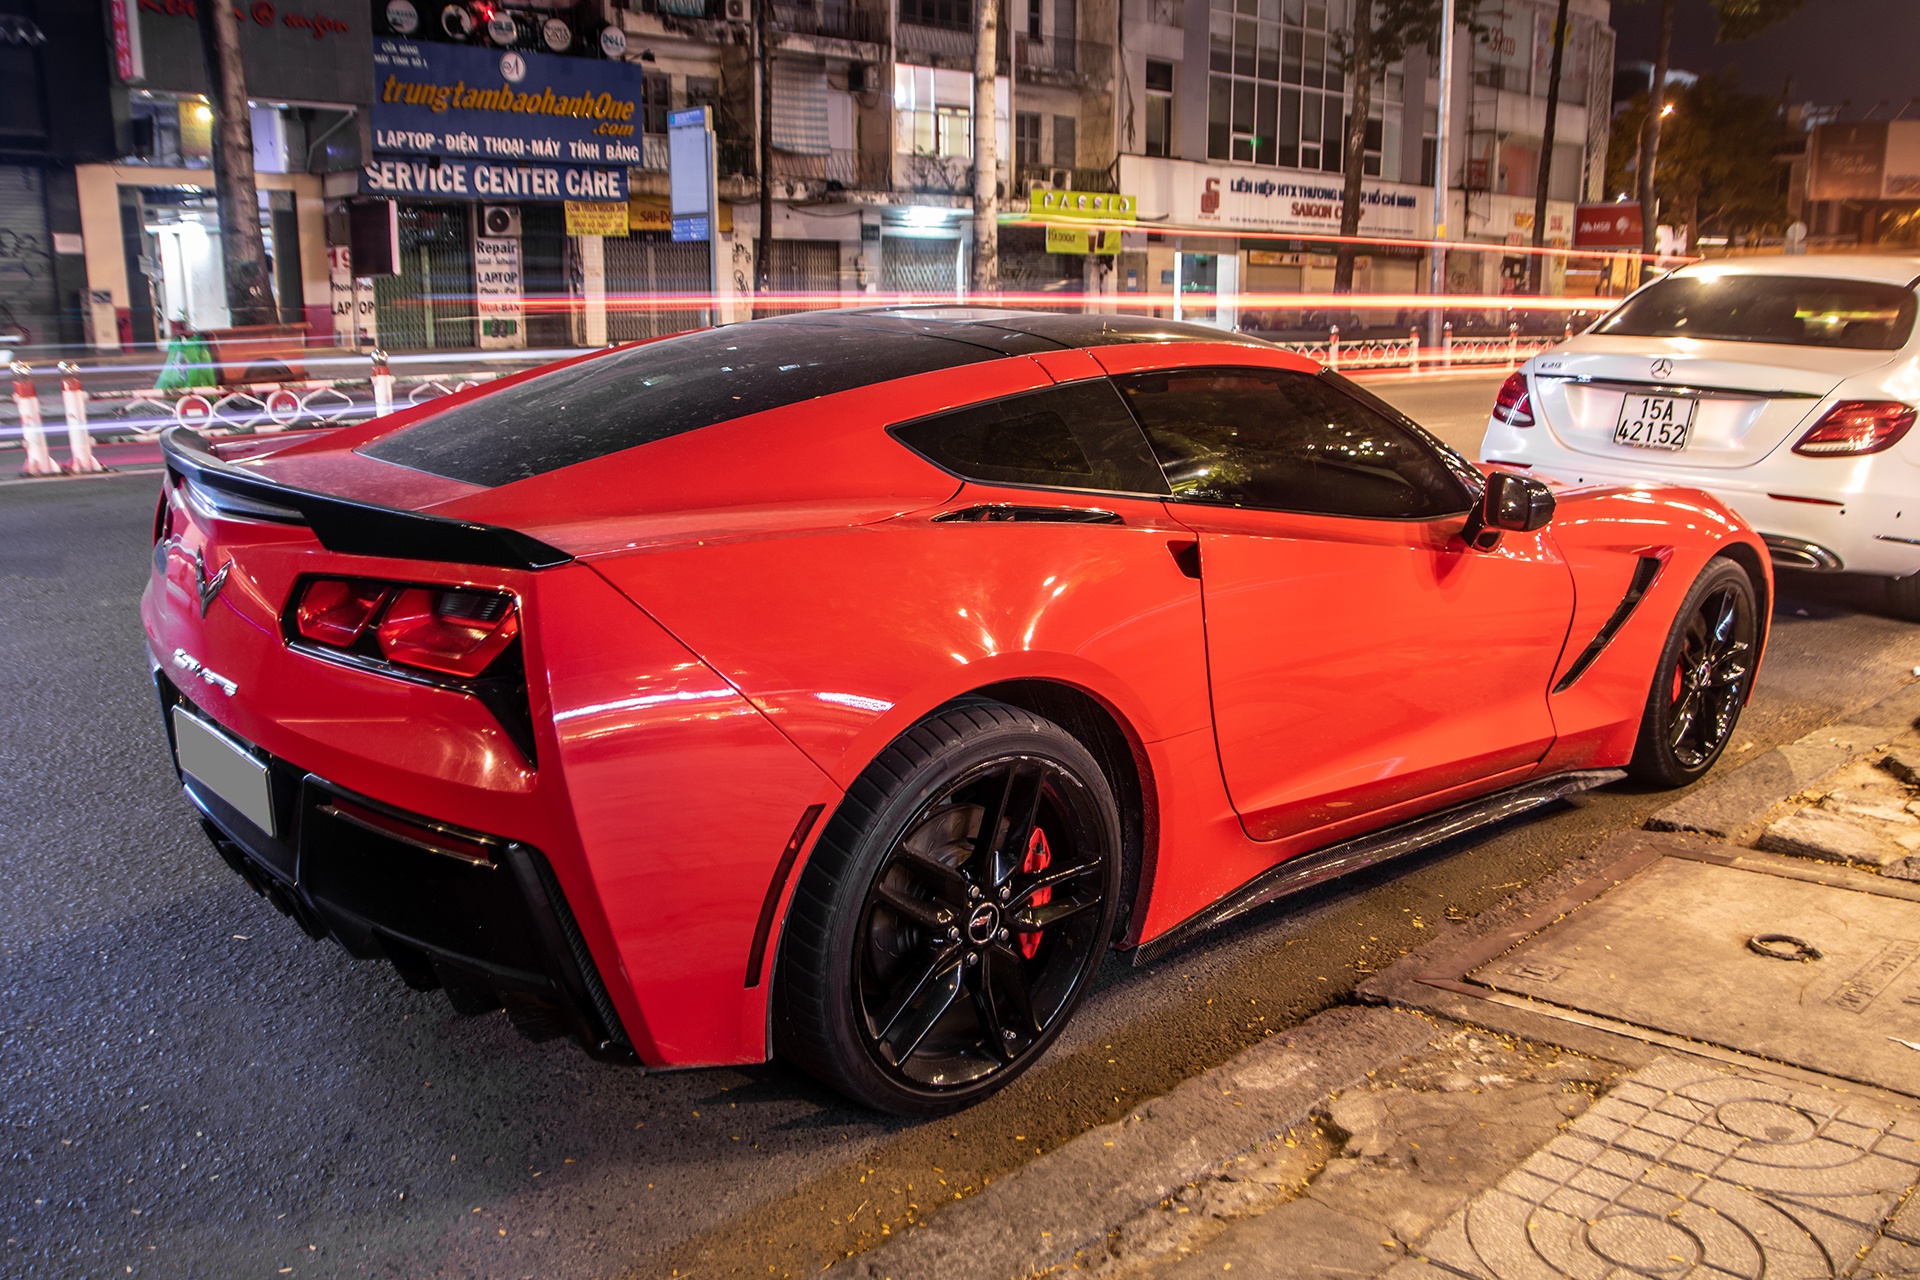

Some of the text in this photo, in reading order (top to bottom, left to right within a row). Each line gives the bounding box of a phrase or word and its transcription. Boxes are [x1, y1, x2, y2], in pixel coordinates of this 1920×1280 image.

[602, 32, 625, 48] DELL
[592, 121, 635, 137] .com
[568, 138, 600, 160] TÍNH
[605, 139, 640, 162] BẢNG
[363, 160, 621, 199] SERVICE CENTER CARE
[1044, 192, 1130, 214] PASSIO
[1291, 201, 1332, 219] SAIGON
[476, 240, 517, 256] Repair
[477, 271, 518, 284] LAPTOP
[1641, 397, 1675, 422] 15A
[1617, 418, 1687, 447] 421.52
